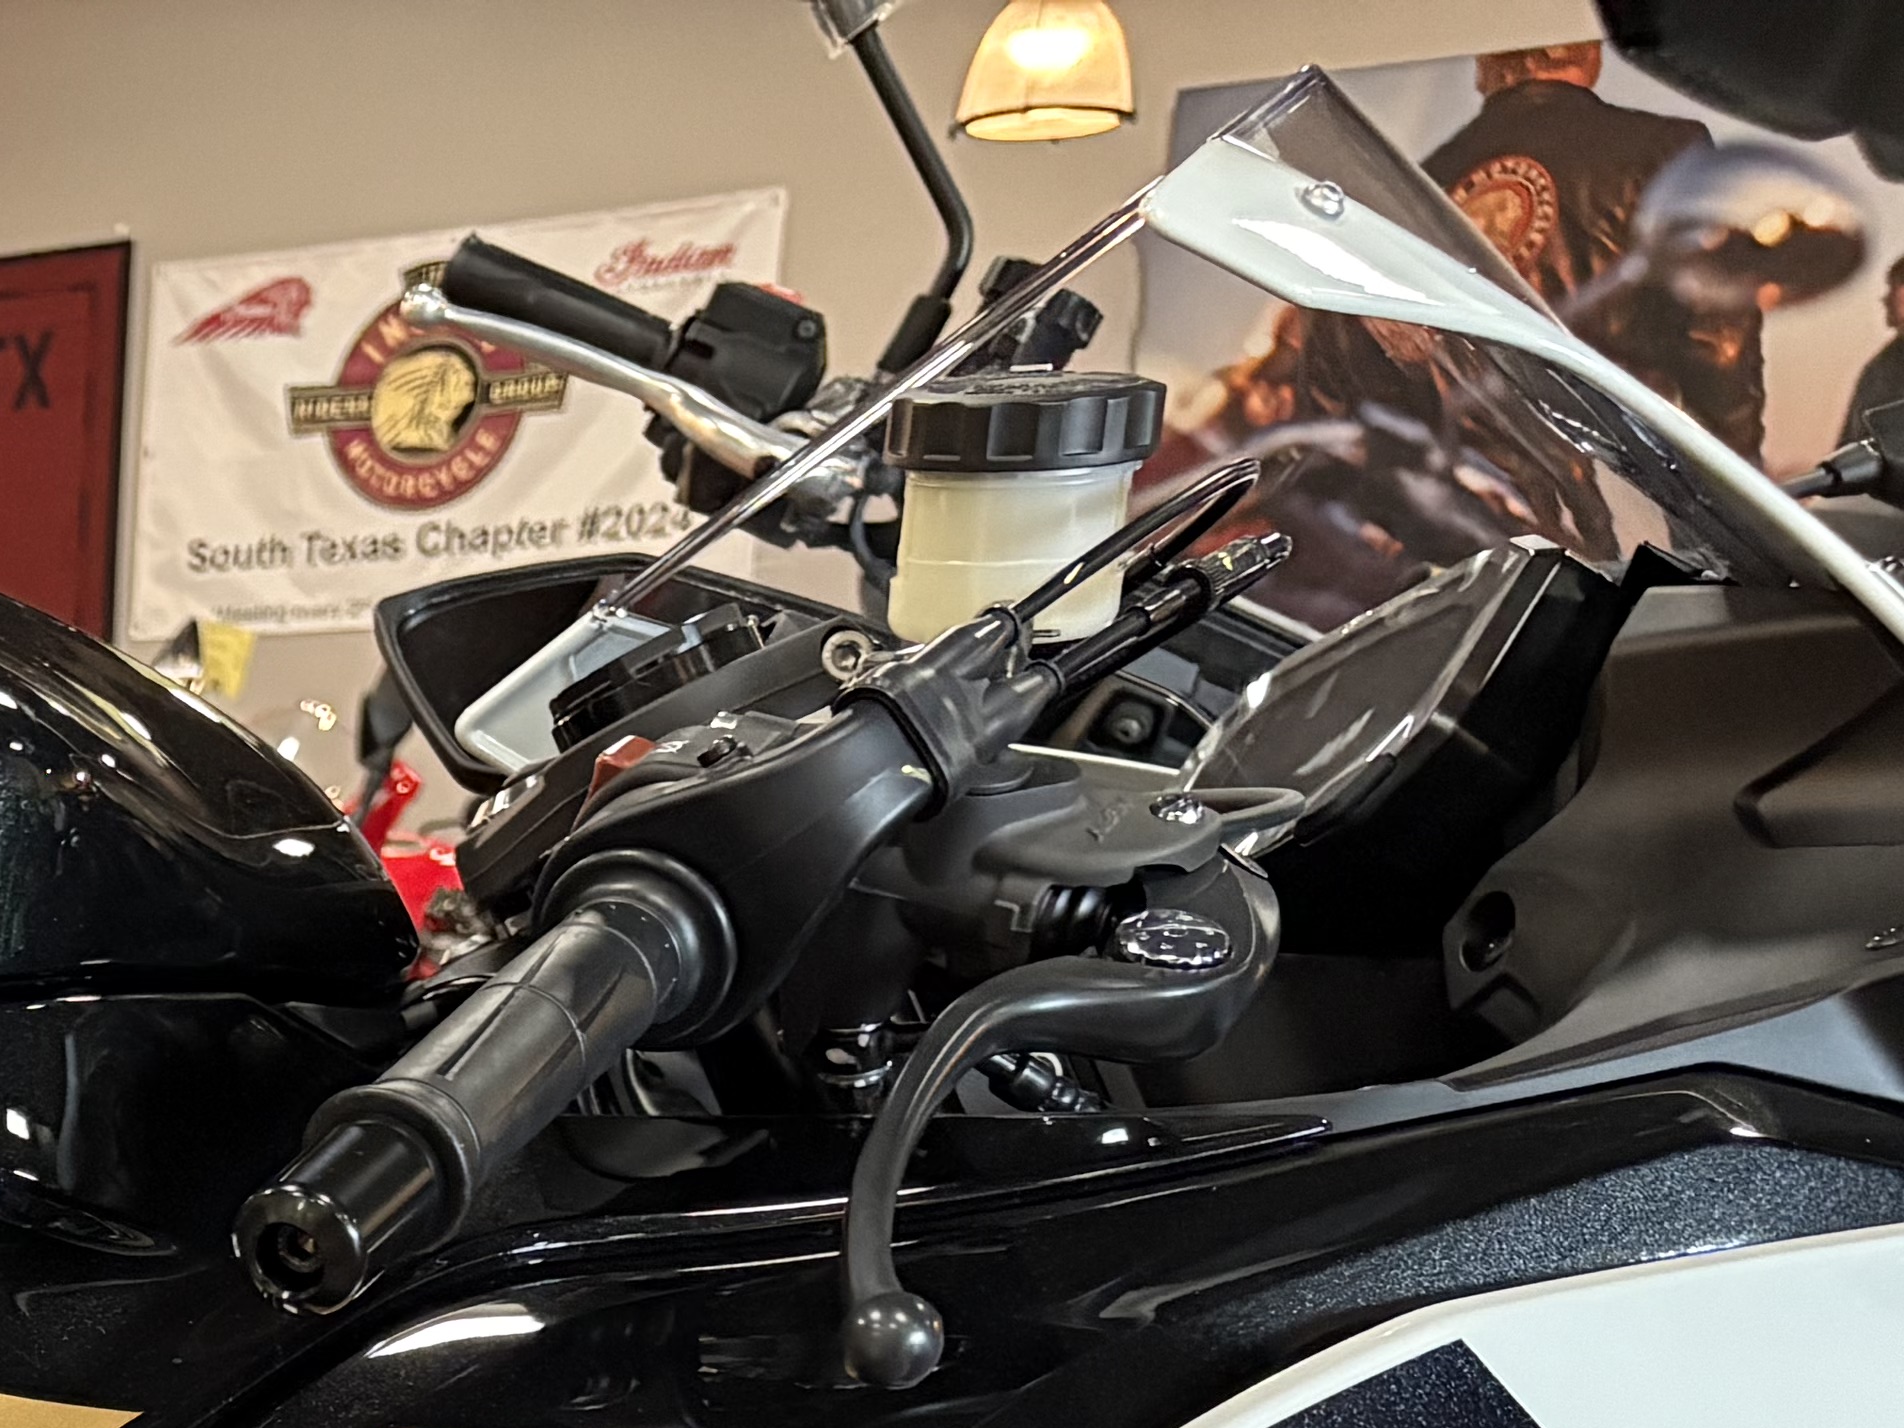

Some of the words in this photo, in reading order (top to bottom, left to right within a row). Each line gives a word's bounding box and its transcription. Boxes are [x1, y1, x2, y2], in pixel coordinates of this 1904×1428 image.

[343, 426, 502, 500] MOTORCYCLE
[187, 536, 289, 573] South
[302, 529, 404, 568] Texas
[415, 518, 568, 561] Chapter
[576, 503, 692, 544] #2024
